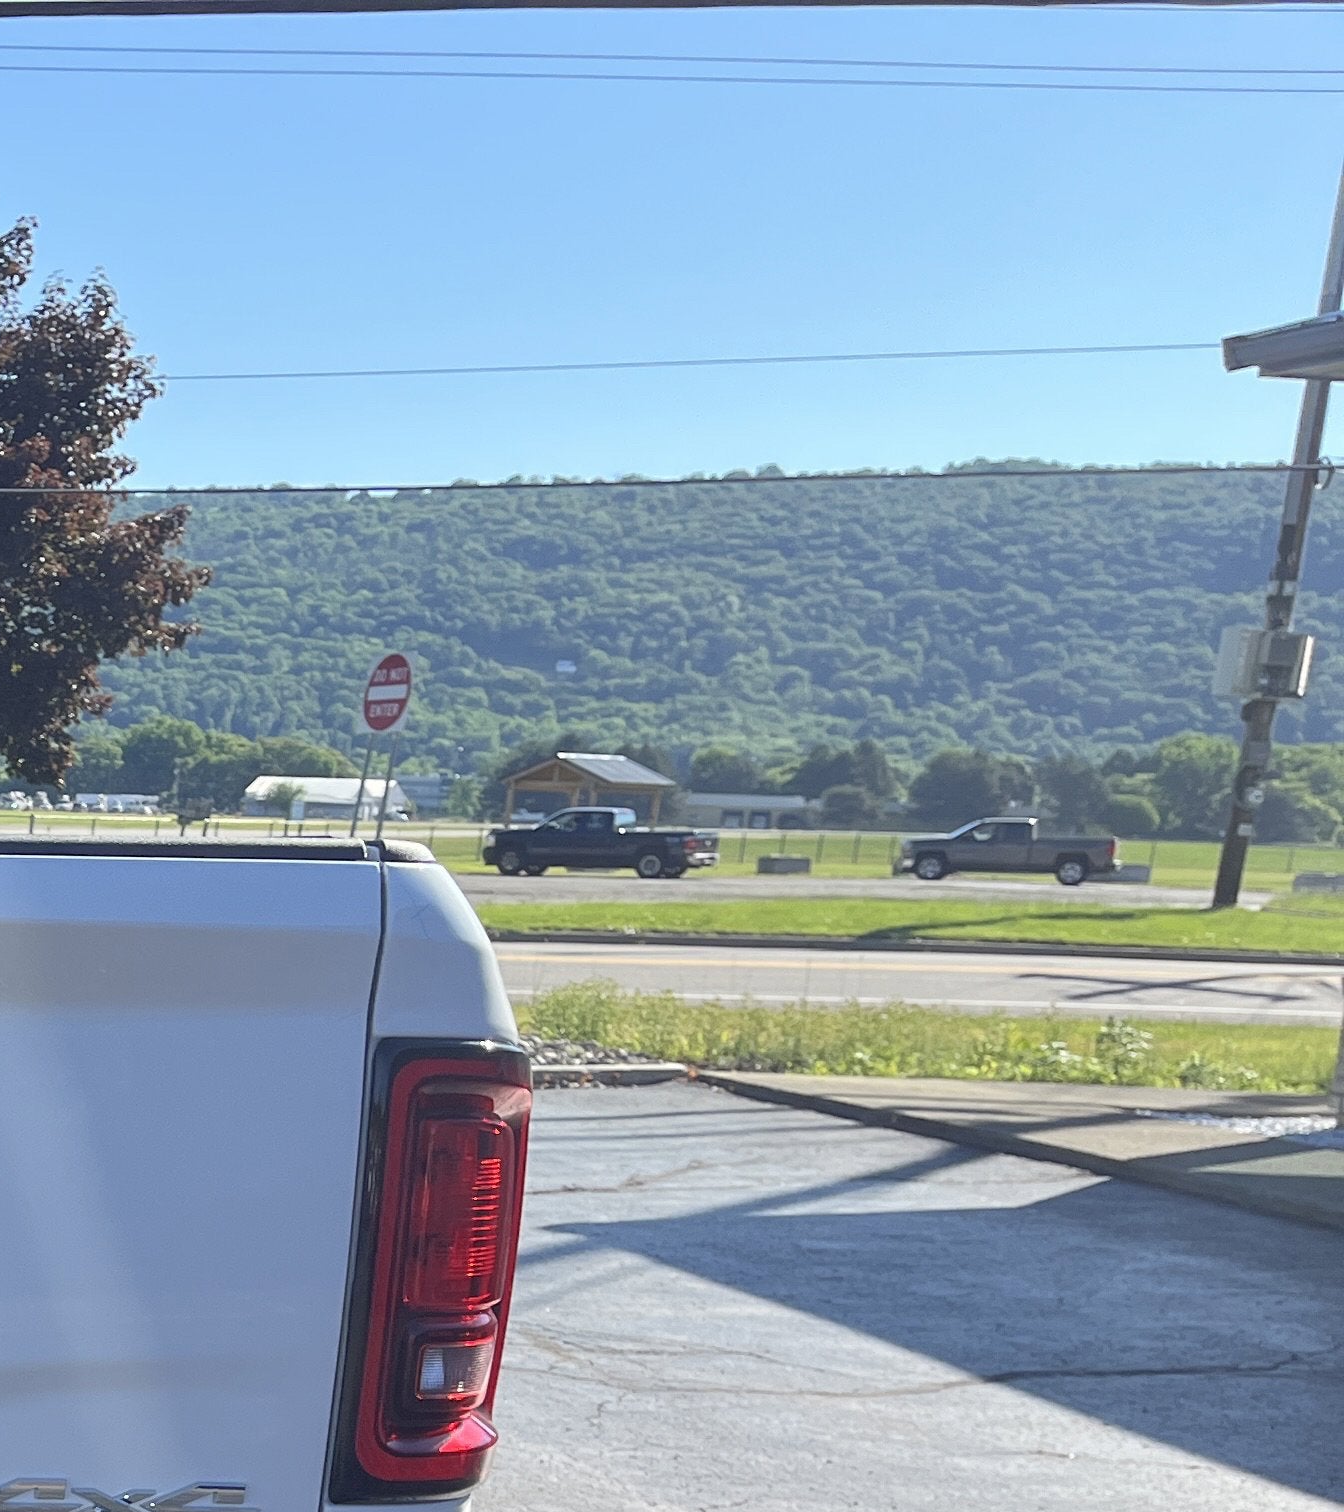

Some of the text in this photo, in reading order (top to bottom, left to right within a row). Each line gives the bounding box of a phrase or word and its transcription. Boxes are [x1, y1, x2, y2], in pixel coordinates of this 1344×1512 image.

[374, 667, 409, 682] DO NOT
[369, 703, 400, 717] ENTER
